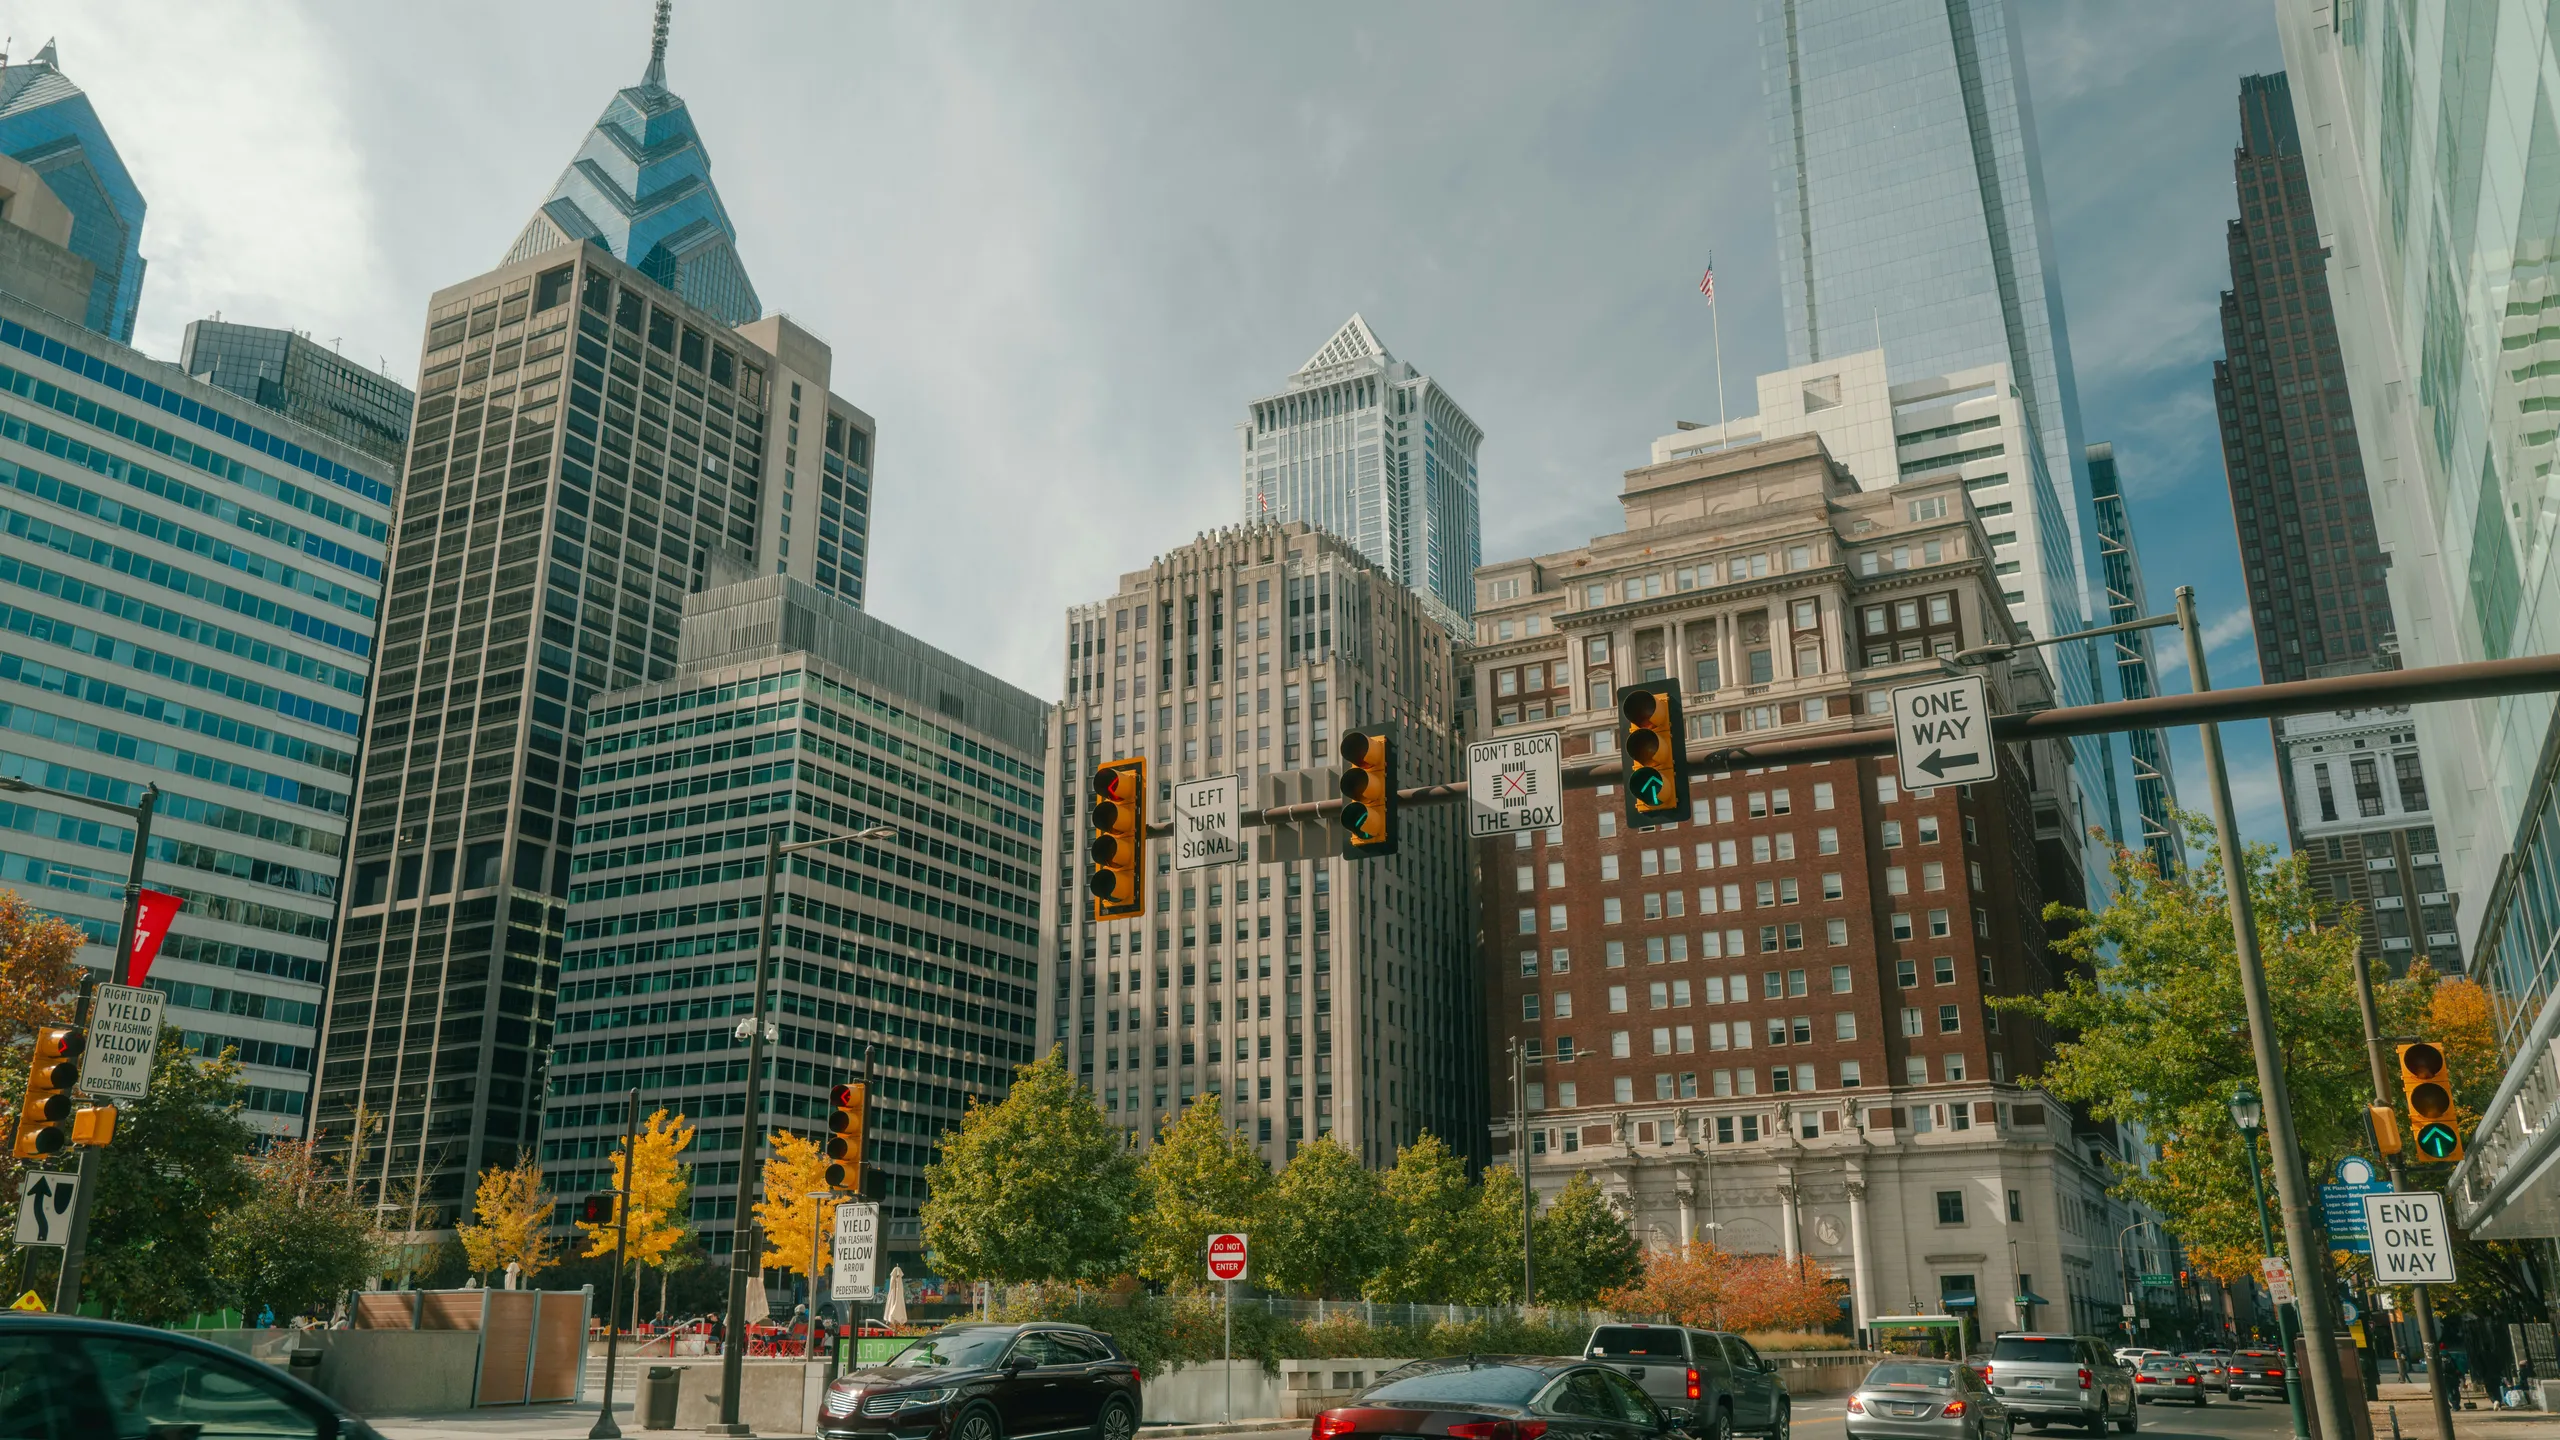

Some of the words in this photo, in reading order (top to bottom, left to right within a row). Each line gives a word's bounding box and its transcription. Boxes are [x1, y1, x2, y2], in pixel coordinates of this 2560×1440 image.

[1912, 689, 1968, 718] ONE
[1912, 716, 1972, 746] WAY
[1474, 744, 1508, 762] DON'T
[1514, 738, 1552, 756] BLOCK
[1190, 788, 1224, 808] LEFT
[1188, 812, 1226, 832] TURN
[1478, 812, 1510, 831] THE
[1520, 806, 1554, 826] BOX
[1182, 836, 1234, 858] SIGNAL
[104, 988, 132, 1002] RIGHT
[135, 992, 160, 1006] TURN
[108, 1002, 151, 1022] YIELD
[98, 1020, 112, 1031] ON
[113, 1022, 152, 1036] FLASHING
[95, 1033, 151, 1054] YELLOW
[102, 1053, 136, 1066] ARROW
[112, 1066, 122, 1078] TO
[86, 1077, 142, 1092] PEDESTRIANS
[842, 1208, 854, 1217] LEFT
[857, 1207, 872, 1216] TURN
[2380, 1203, 2428, 1223] END
[843, 1219, 870, 1232] YIELD
[839, 1236, 846, 1245] ON
[848, 1235, 872, 1244] FLASHING
[2385, 1228, 2434, 1247] ONE
[838, 1247, 872, 1260] YELLOW
[2387, 1253, 2436, 1272] WAY
[844, 1263, 864, 1272] ARROW
[850, 1274, 857, 1283] TO
[835, 1285, 869, 1294] PEDESTRIANS
